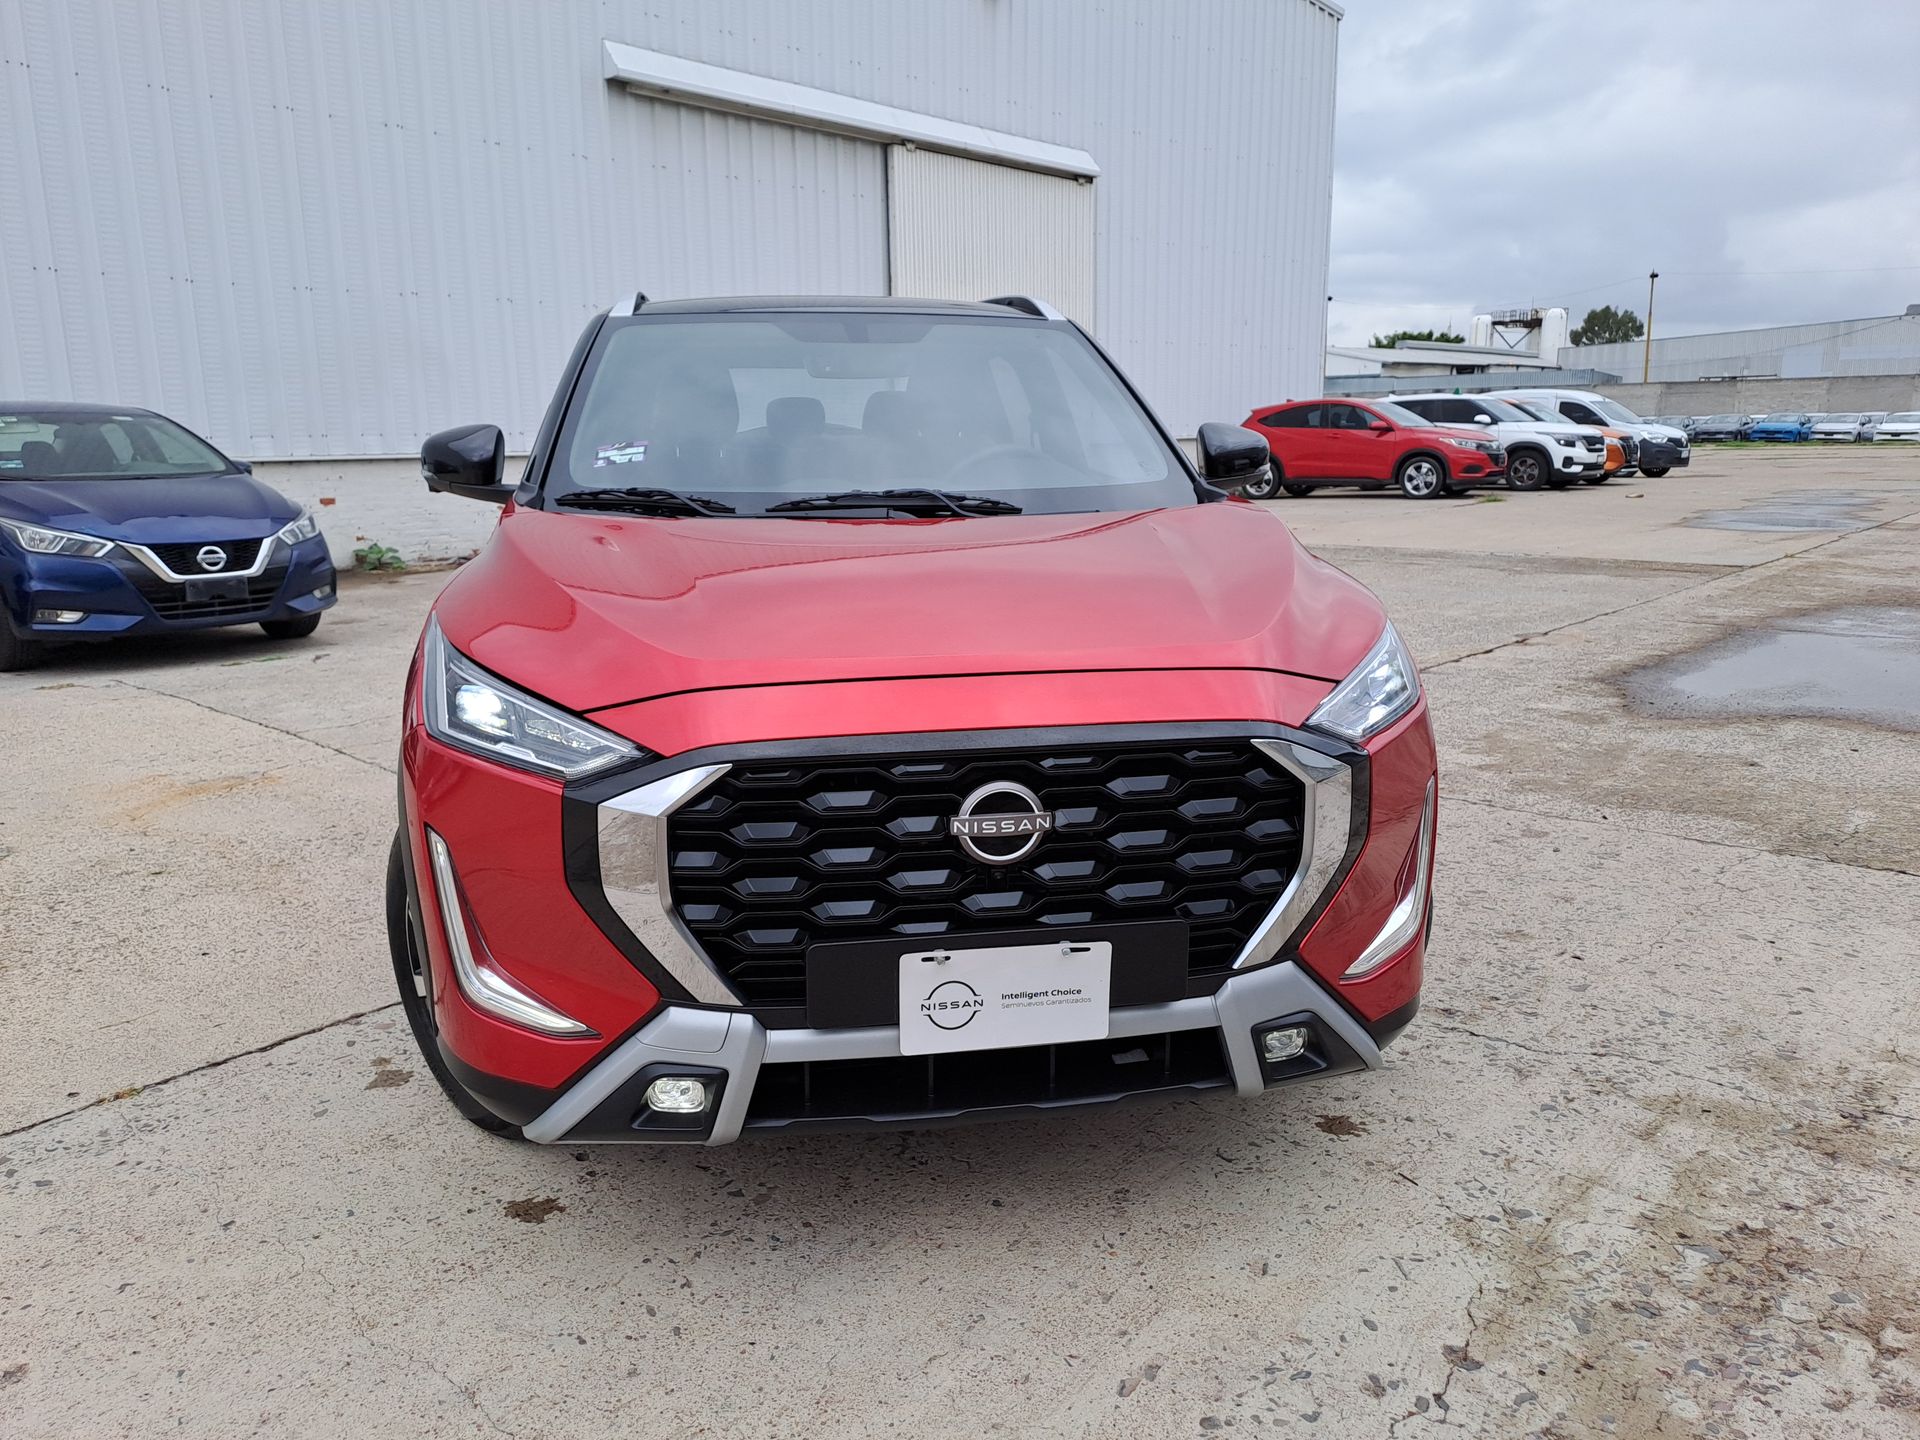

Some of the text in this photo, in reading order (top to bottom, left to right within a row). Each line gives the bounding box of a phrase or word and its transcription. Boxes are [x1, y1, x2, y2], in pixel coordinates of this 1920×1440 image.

[953, 816, 1050, 834] NISSAN
[1001, 988, 1082, 1000] Intelligent Choice
[921, 999, 984, 1011] NISSAN
[1001, 997, 1092, 1009] Seminuevos Garantizados
